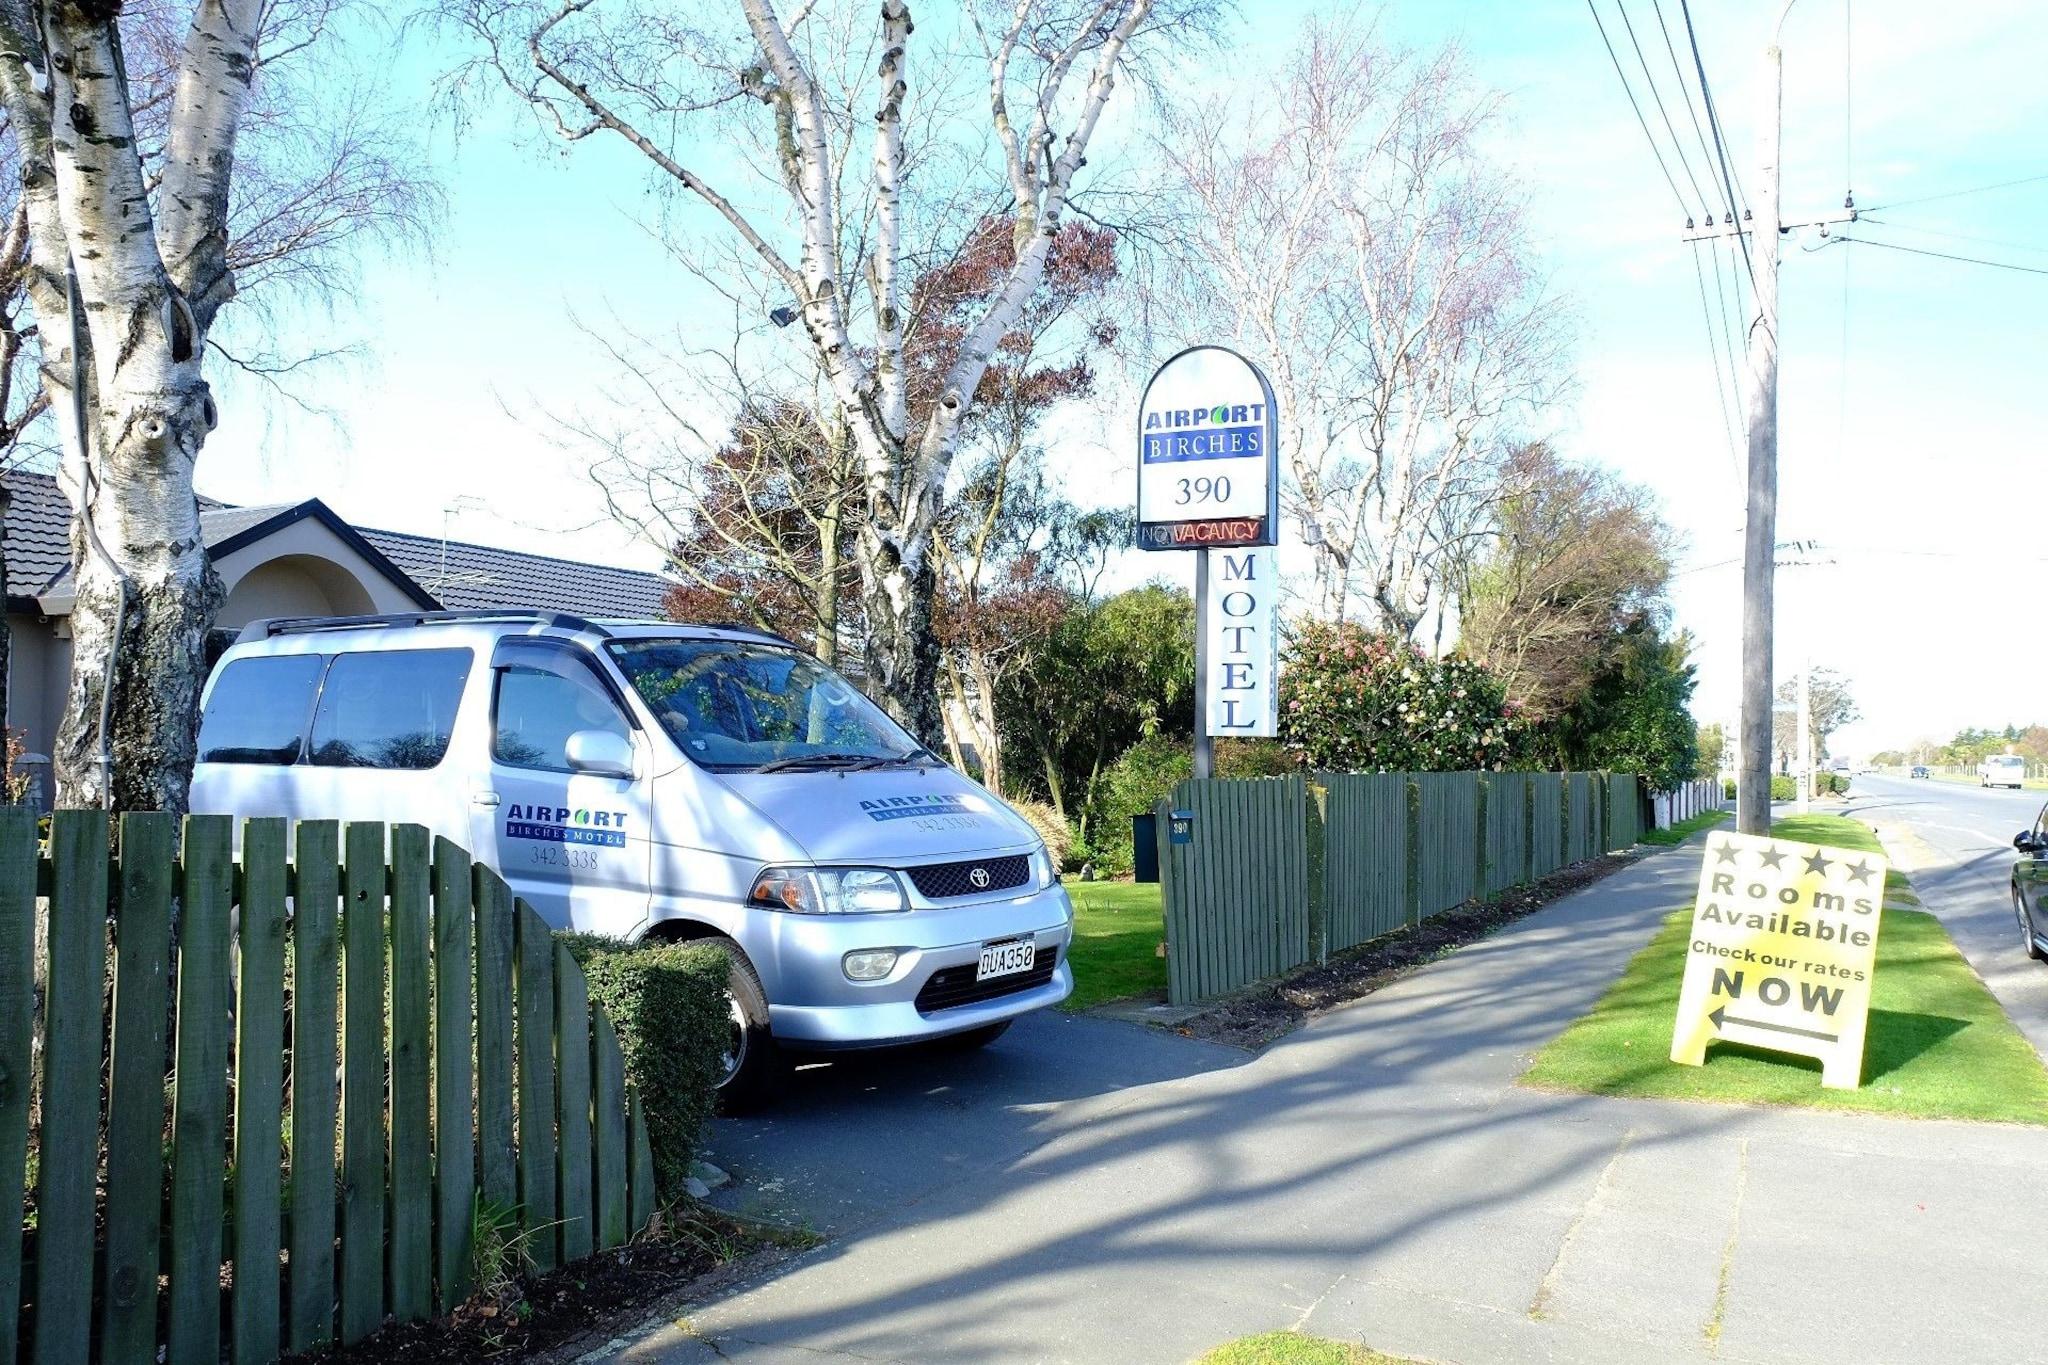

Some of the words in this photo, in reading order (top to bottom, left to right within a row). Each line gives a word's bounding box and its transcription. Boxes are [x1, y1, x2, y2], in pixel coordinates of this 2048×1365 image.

[1145, 403, 1265, 430] AIRPORT
[1150, 432, 1259, 458] BIRCHES
[1175, 475, 1232, 505] 390
[1173, 521, 1260, 543] VACANCY
[1221, 554, 1256, 728] MOTEL
[507, 804, 628, 827] AIRPORT
[509, 826, 568, 839] BIRCHES
[574, 831, 623, 844] MOTEL
[530, 846, 558, 864] 342
[562, 849, 598, 869] 3338
[1711, 872, 1873, 916] Rooms
[1700, 903, 1870, 947] Available
[982, 946, 1032, 975] DUA350
[1692, 940, 1755, 962] Check
[1760, 953, 1797, 970] our
[1804, 960, 1865, 982] rates
[1711, 967, 1844, 1016] NOW
